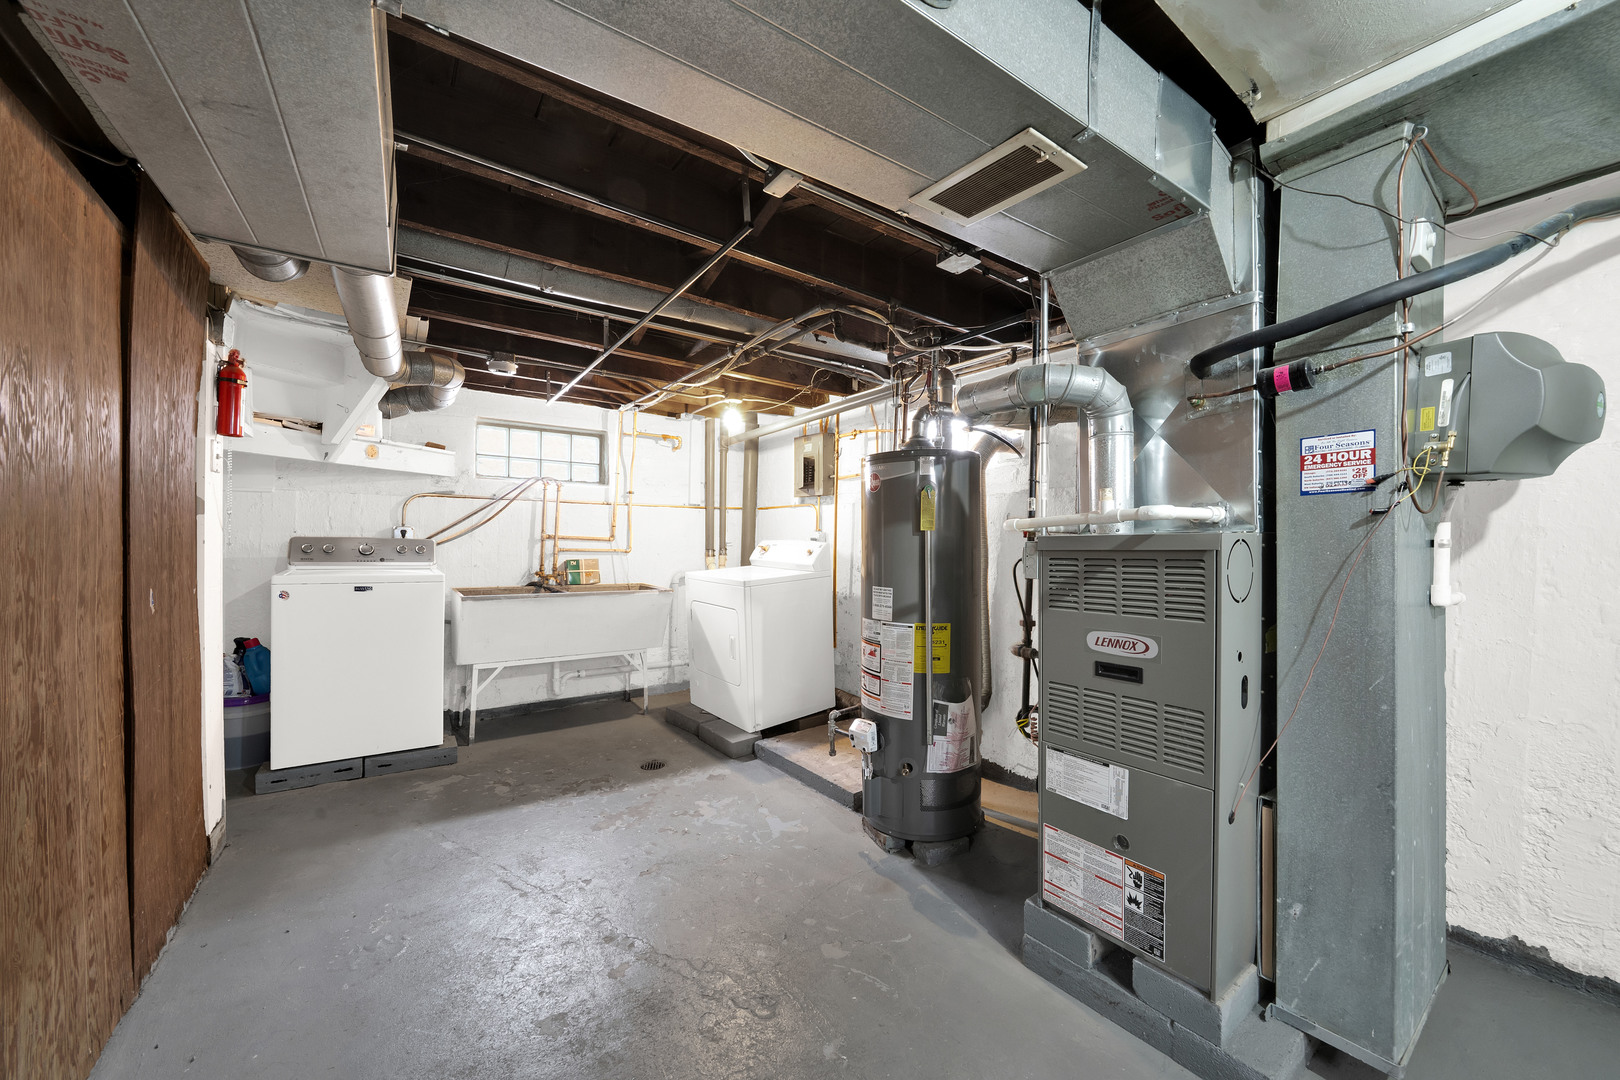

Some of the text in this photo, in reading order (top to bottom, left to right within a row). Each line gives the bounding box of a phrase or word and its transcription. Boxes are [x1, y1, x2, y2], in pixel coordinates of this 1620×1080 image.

[1304, 454, 1322, 465] 24
[1326, 450, 1372, 462] HOUR
[1304, 462, 1342, 470] EMERGENCY
[1094, 636, 1139, 651] LENNOX
